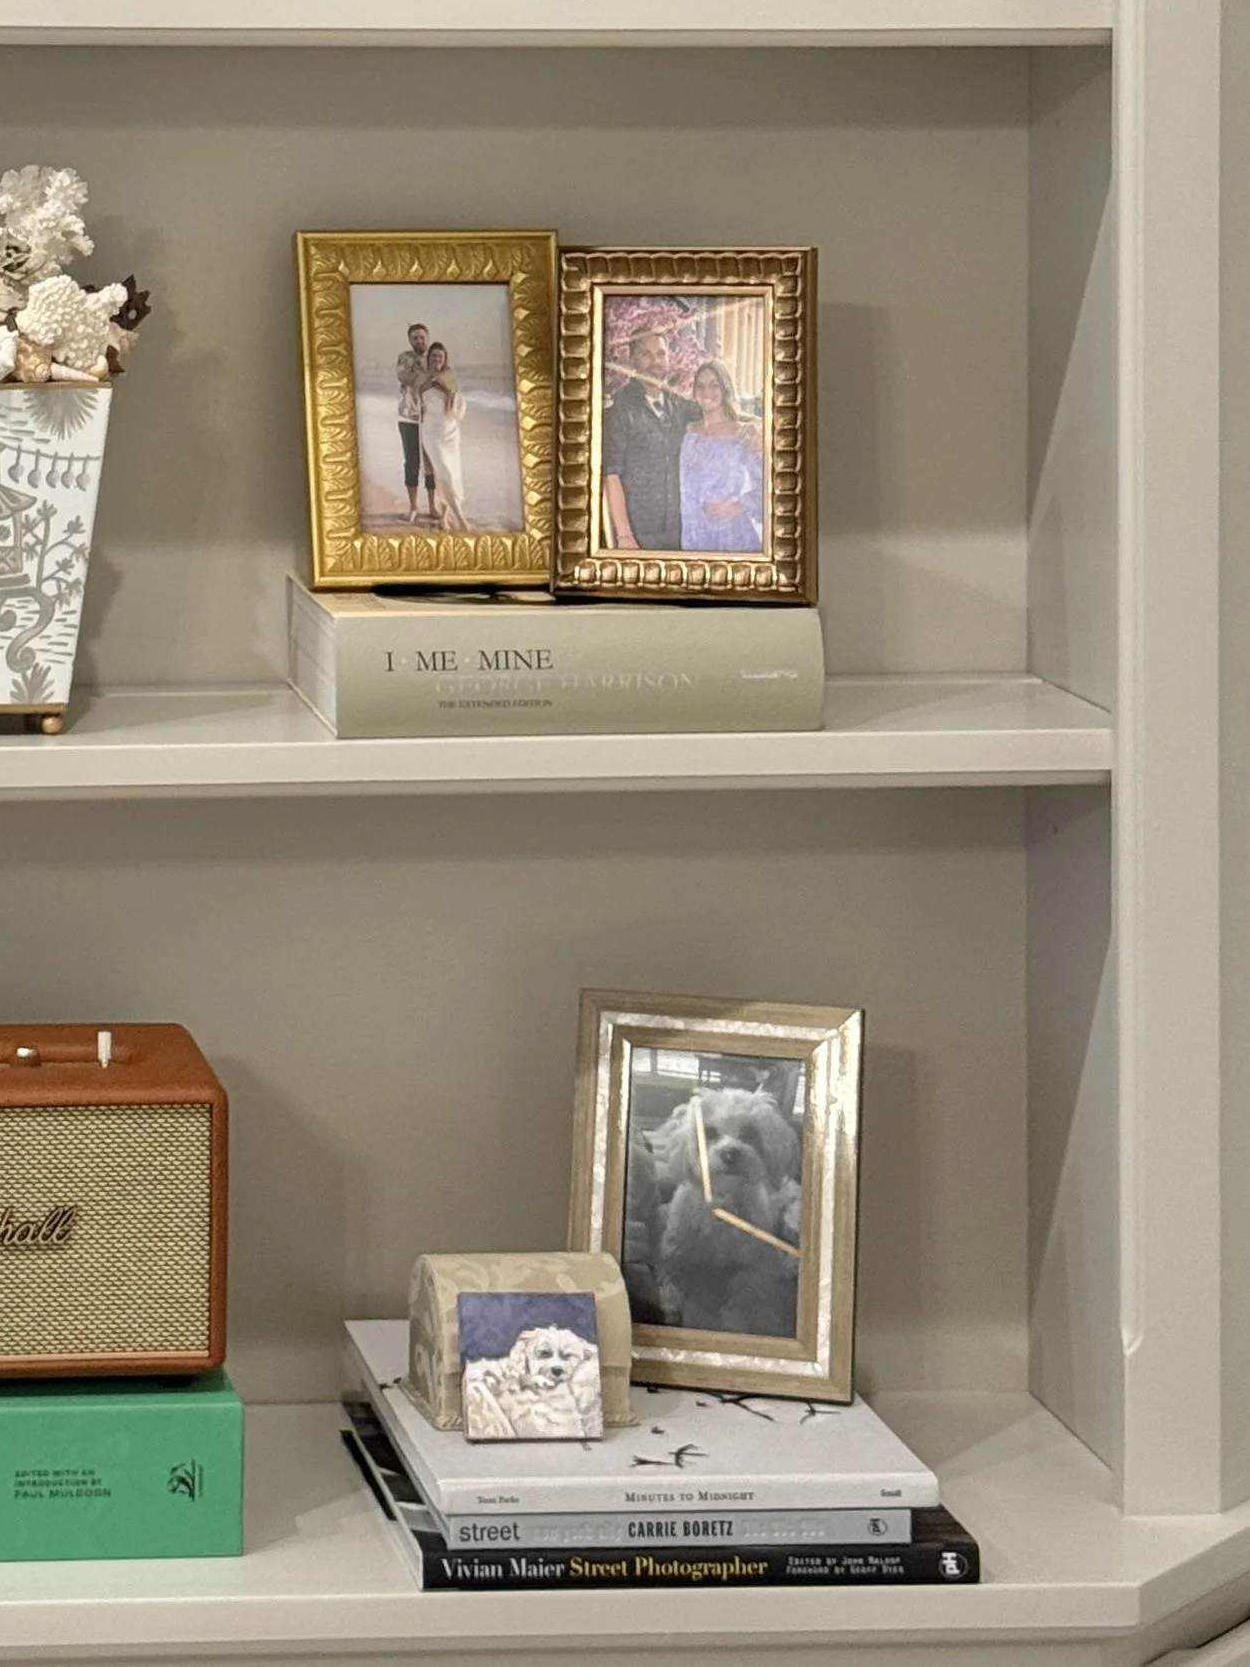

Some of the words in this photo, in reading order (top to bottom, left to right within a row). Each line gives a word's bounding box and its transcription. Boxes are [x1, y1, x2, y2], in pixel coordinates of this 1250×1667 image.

[385, 651, 395, 671] I
[415, 650, 458, 672] ME
[478, 649, 553, 671] MINE
[459, 1522, 520, 1542] street
[628, 1521, 677, 1538] CARRIE
[683, 1520, 733, 1537] BORETZ
[441, 1558, 503, 1579] Vivian
[509, 1557, 565, 1578] Maier
[569, 1556, 628, 1577] Street
[634, 1555, 769, 1581] Photographer
